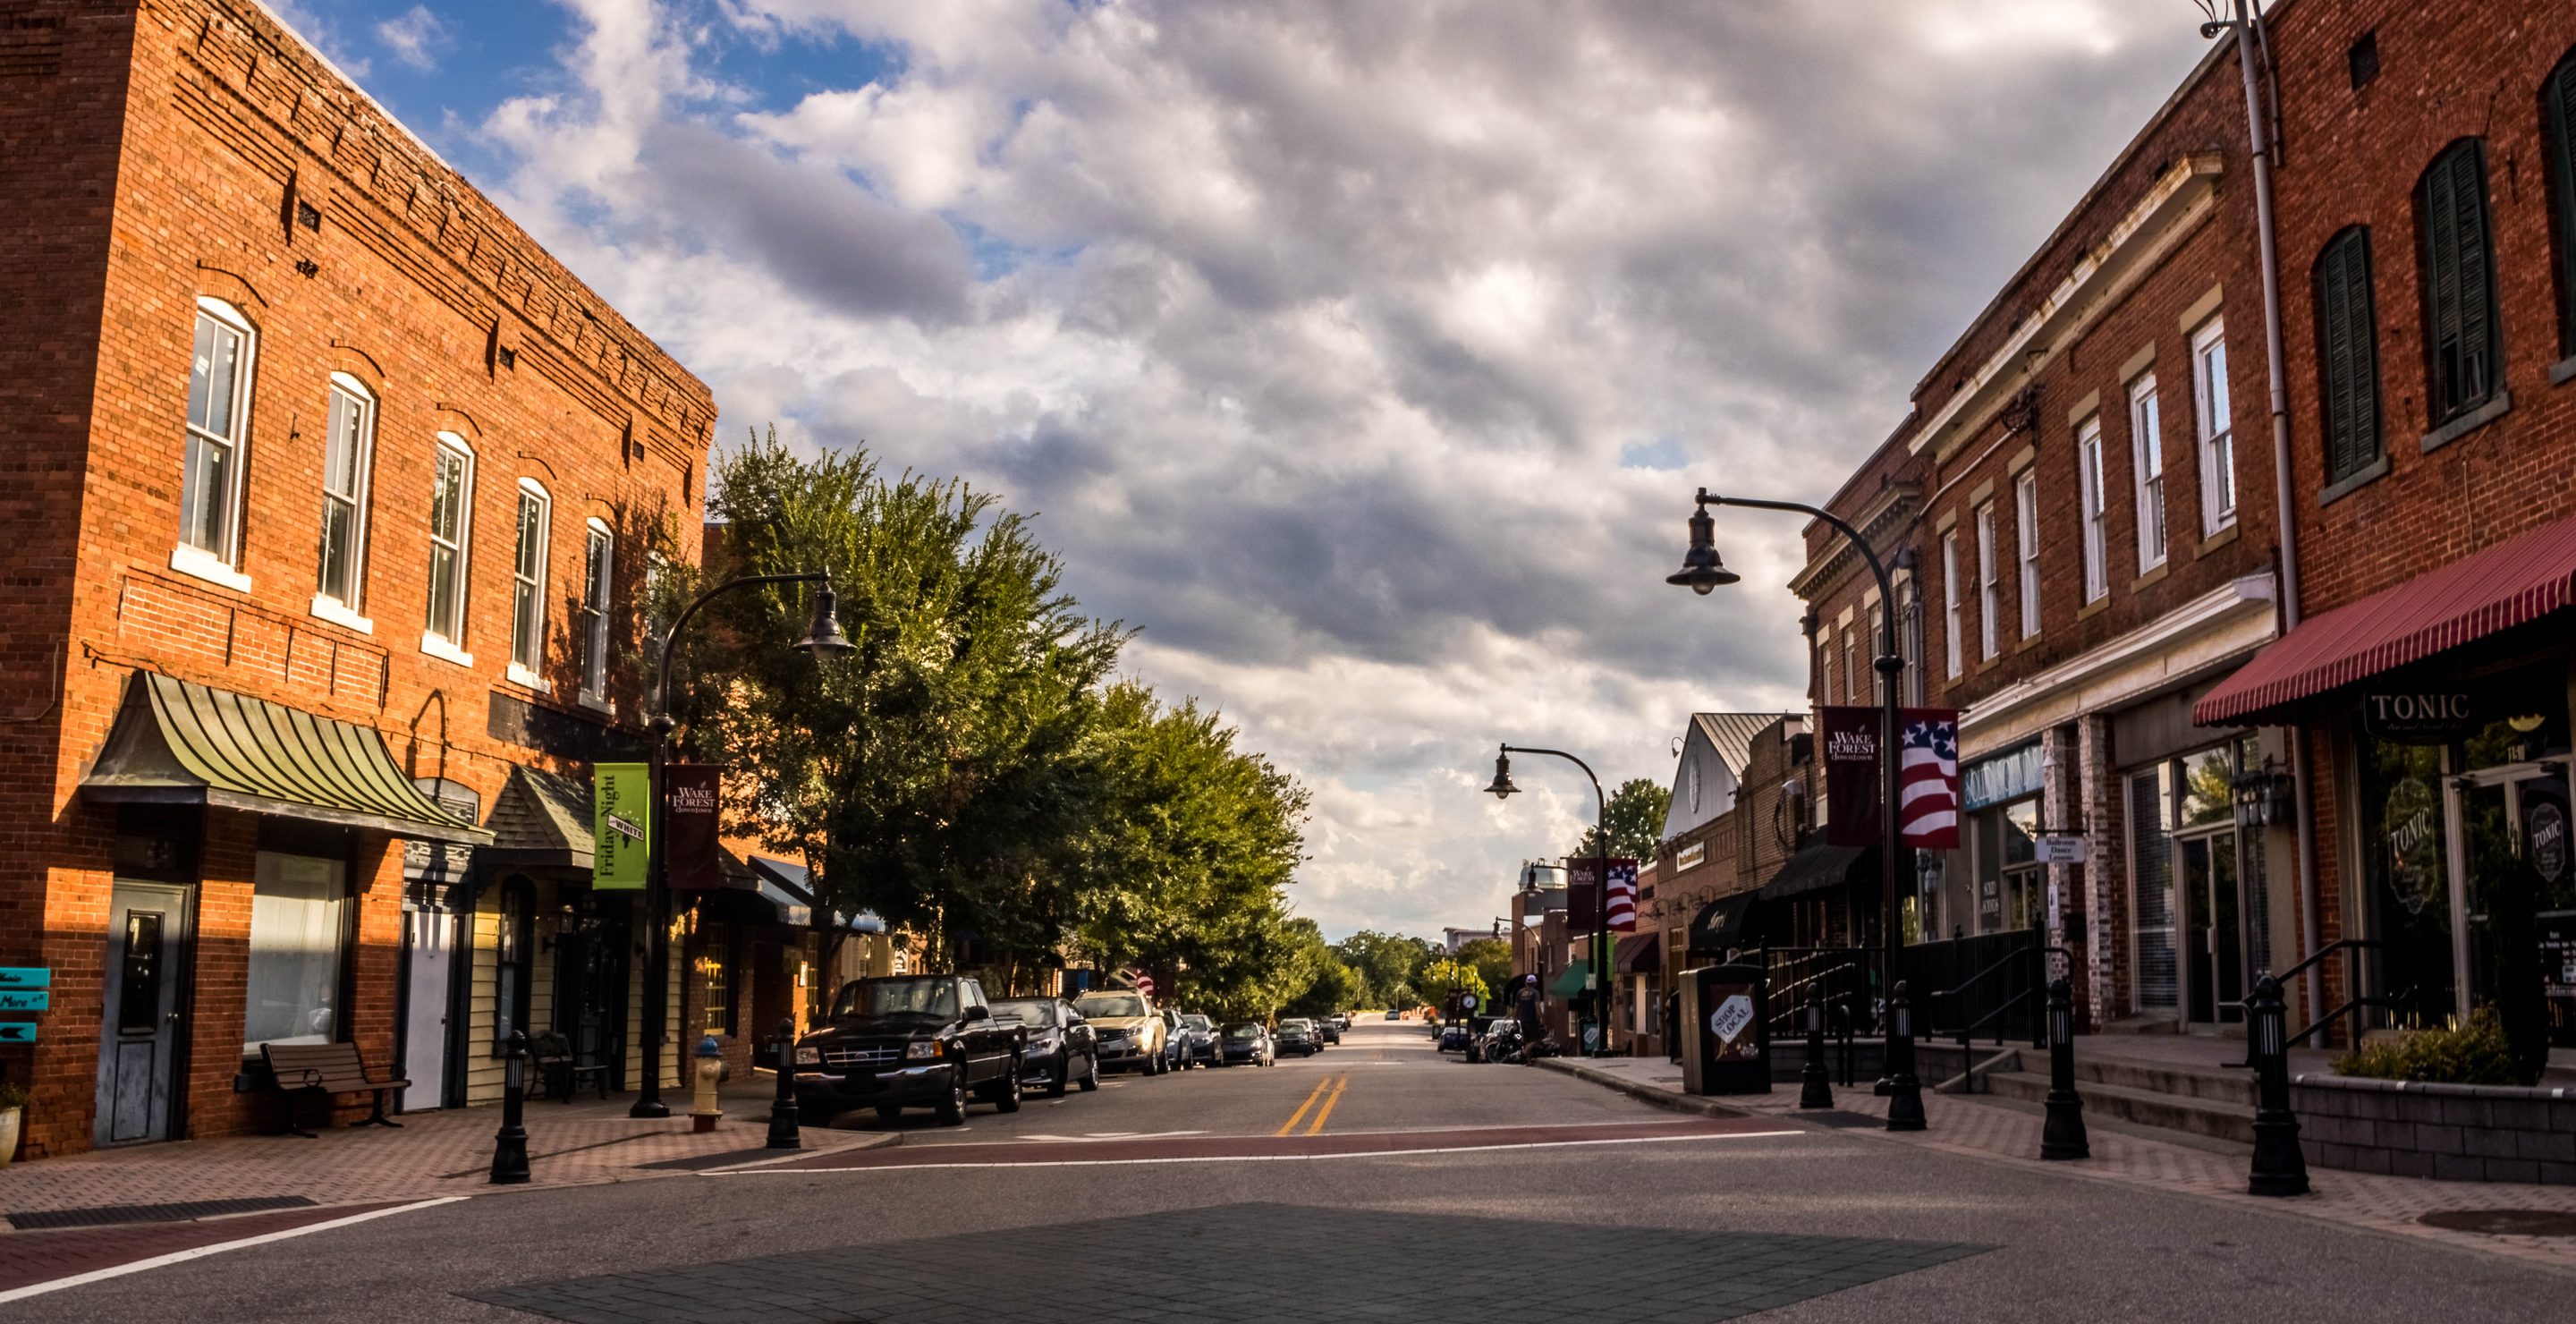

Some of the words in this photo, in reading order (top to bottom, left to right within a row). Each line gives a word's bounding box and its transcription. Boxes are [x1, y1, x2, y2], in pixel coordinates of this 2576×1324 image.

[2370, 693, 2470, 721] TONIC
[1828, 741, 1877, 754] FOREST
[1834, 731, 1872, 744] WAKE
[1831, 751, 1873, 761] downtown
[600, 775, 620, 818] Night
[673, 794, 716, 808] FOREST
[678, 786, 713, 799] WAKE
[674, 804, 713, 814] downtown
[615, 819, 644, 839] WHITE
[2390, 807, 2431, 859] TONIC
[2533, 819, 2561, 849] TONIC
[600, 826, 619, 877] Friday
[2051, 845, 2072, 853] Dance
[1715, 1004, 1735, 1030] SHOP
[1722, 1008, 1750, 1036] LOCAL
